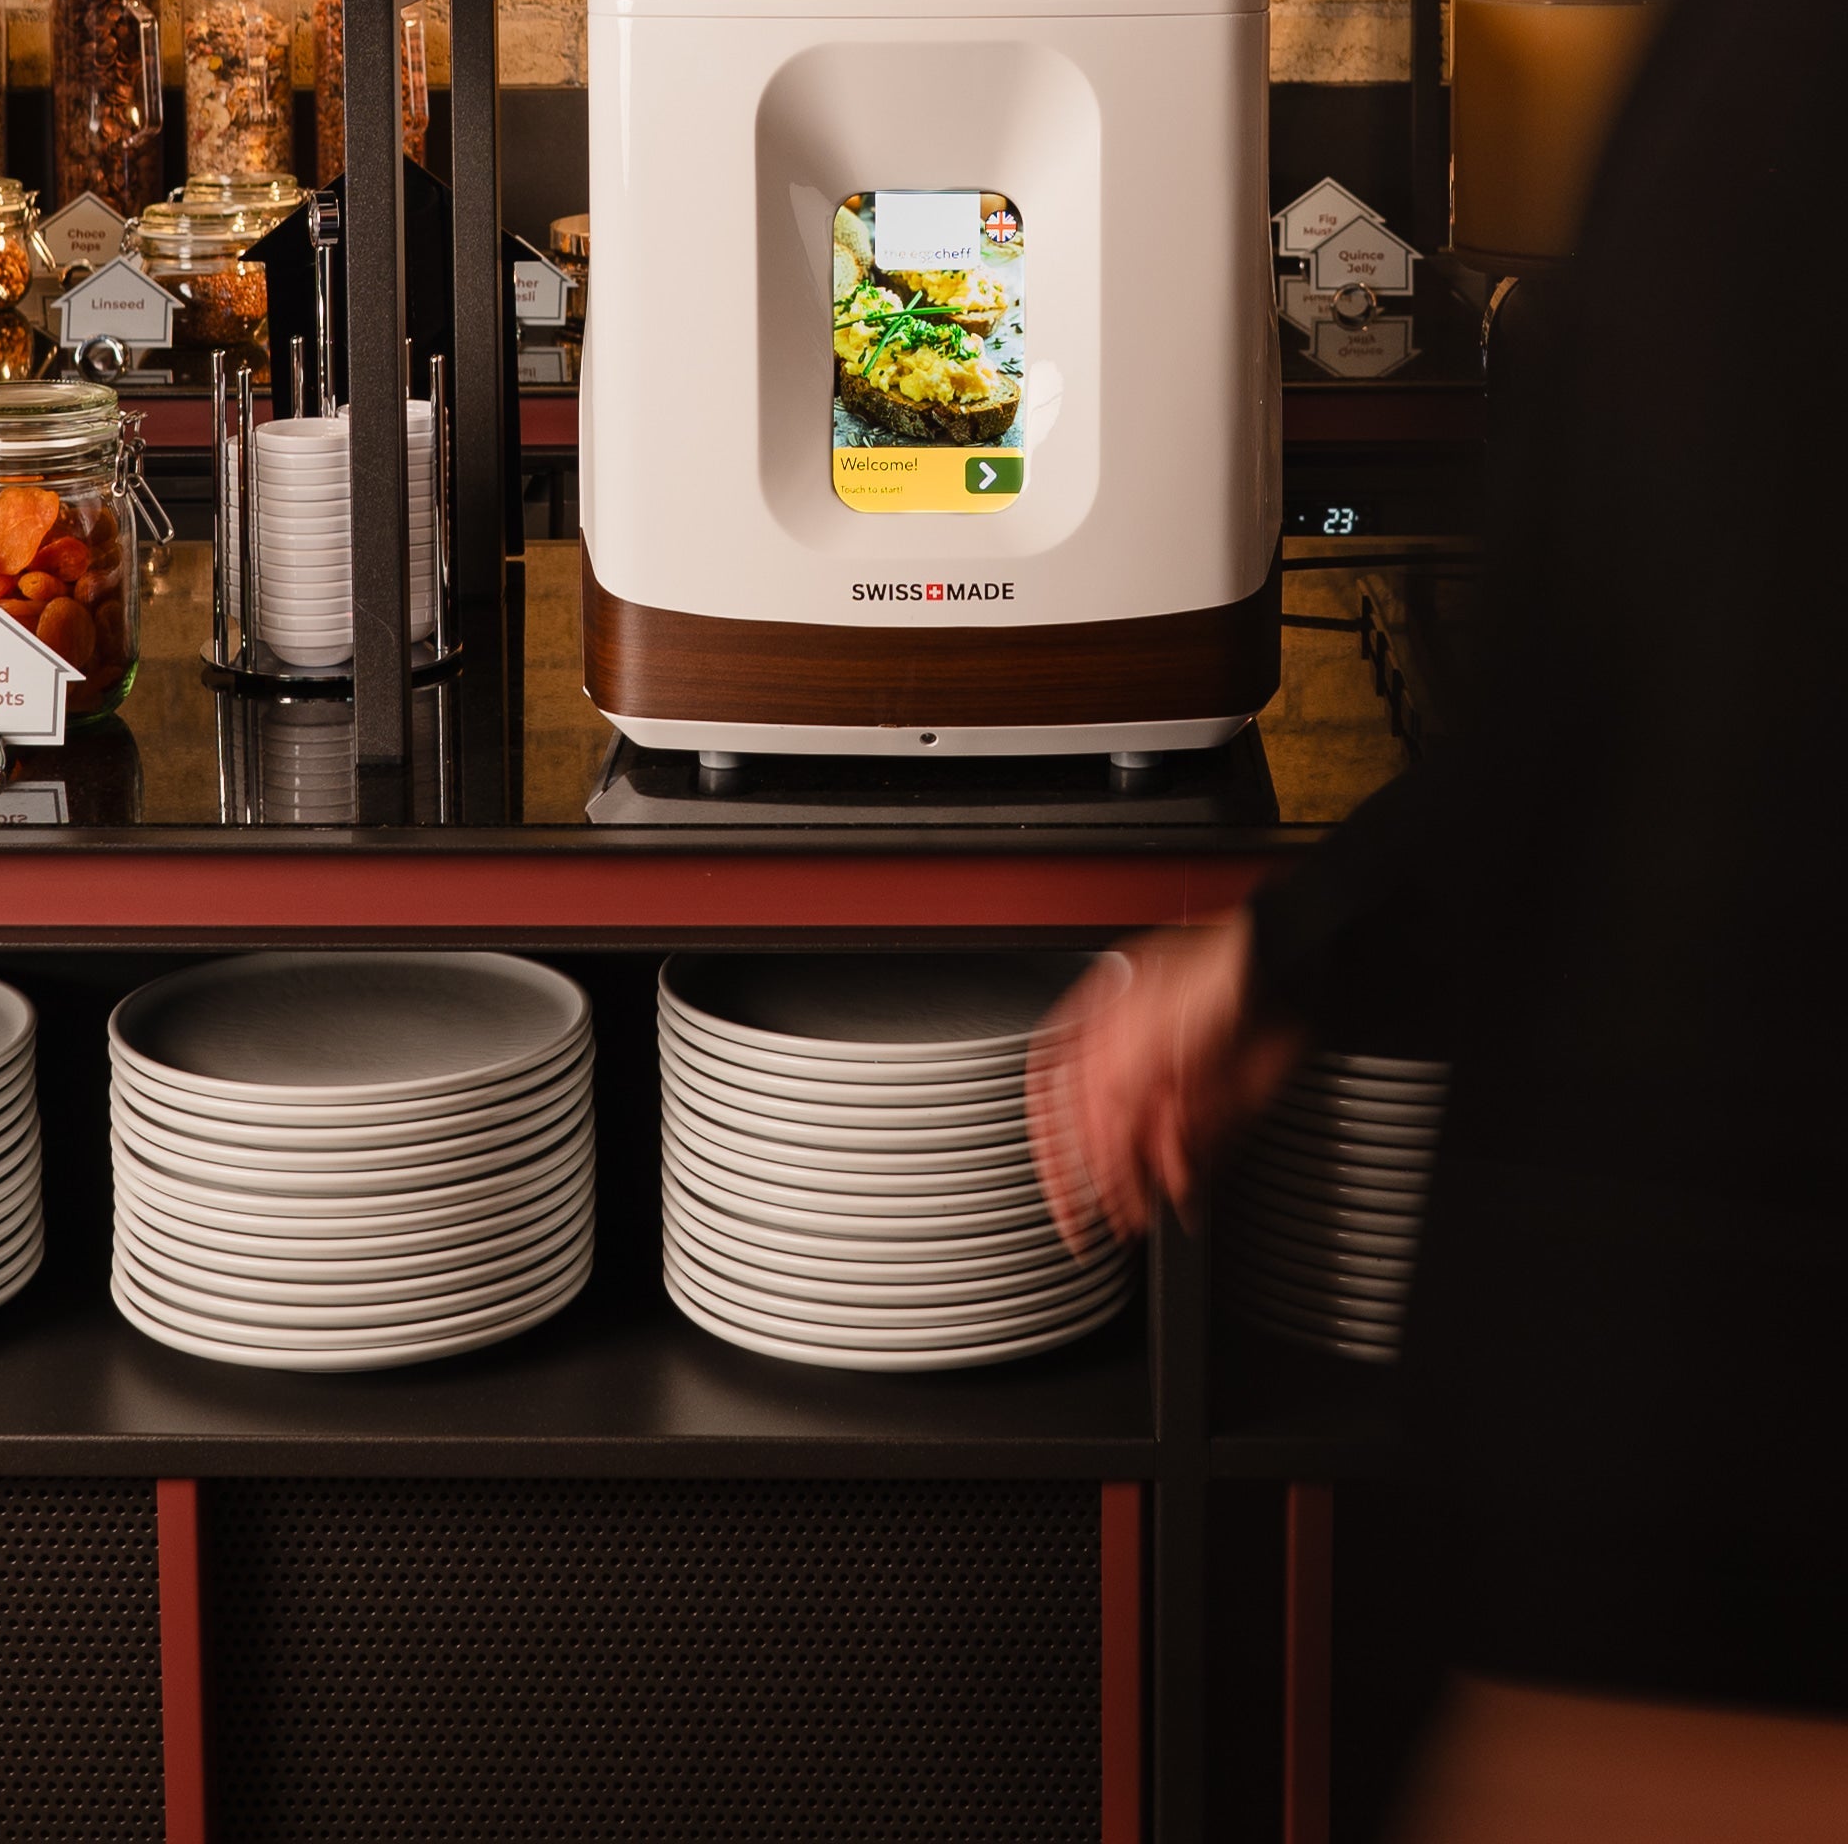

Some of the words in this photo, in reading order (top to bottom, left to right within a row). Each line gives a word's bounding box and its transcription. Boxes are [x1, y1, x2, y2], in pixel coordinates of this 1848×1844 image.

[1319, 214, 1337, 226] Fig
[67, 228, 106, 239] Choco
[71, 241, 101, 253] Pops
[1338, 250, 1384, 262] Quince
[1347, 263, 1376, 275] Jelly
[91, 298, 145, 310] Linseed
[840, 457, 918, 472] Welcome!
[840, 485, 866, 494] Touch
[868, 486, 878, 494] to
[880, 485, 903, 494] start!
[1323, 508, 1354, 534] 23
[852, 583, 922, 601] SWISS
[947, 583, 1014, 601] MADE
